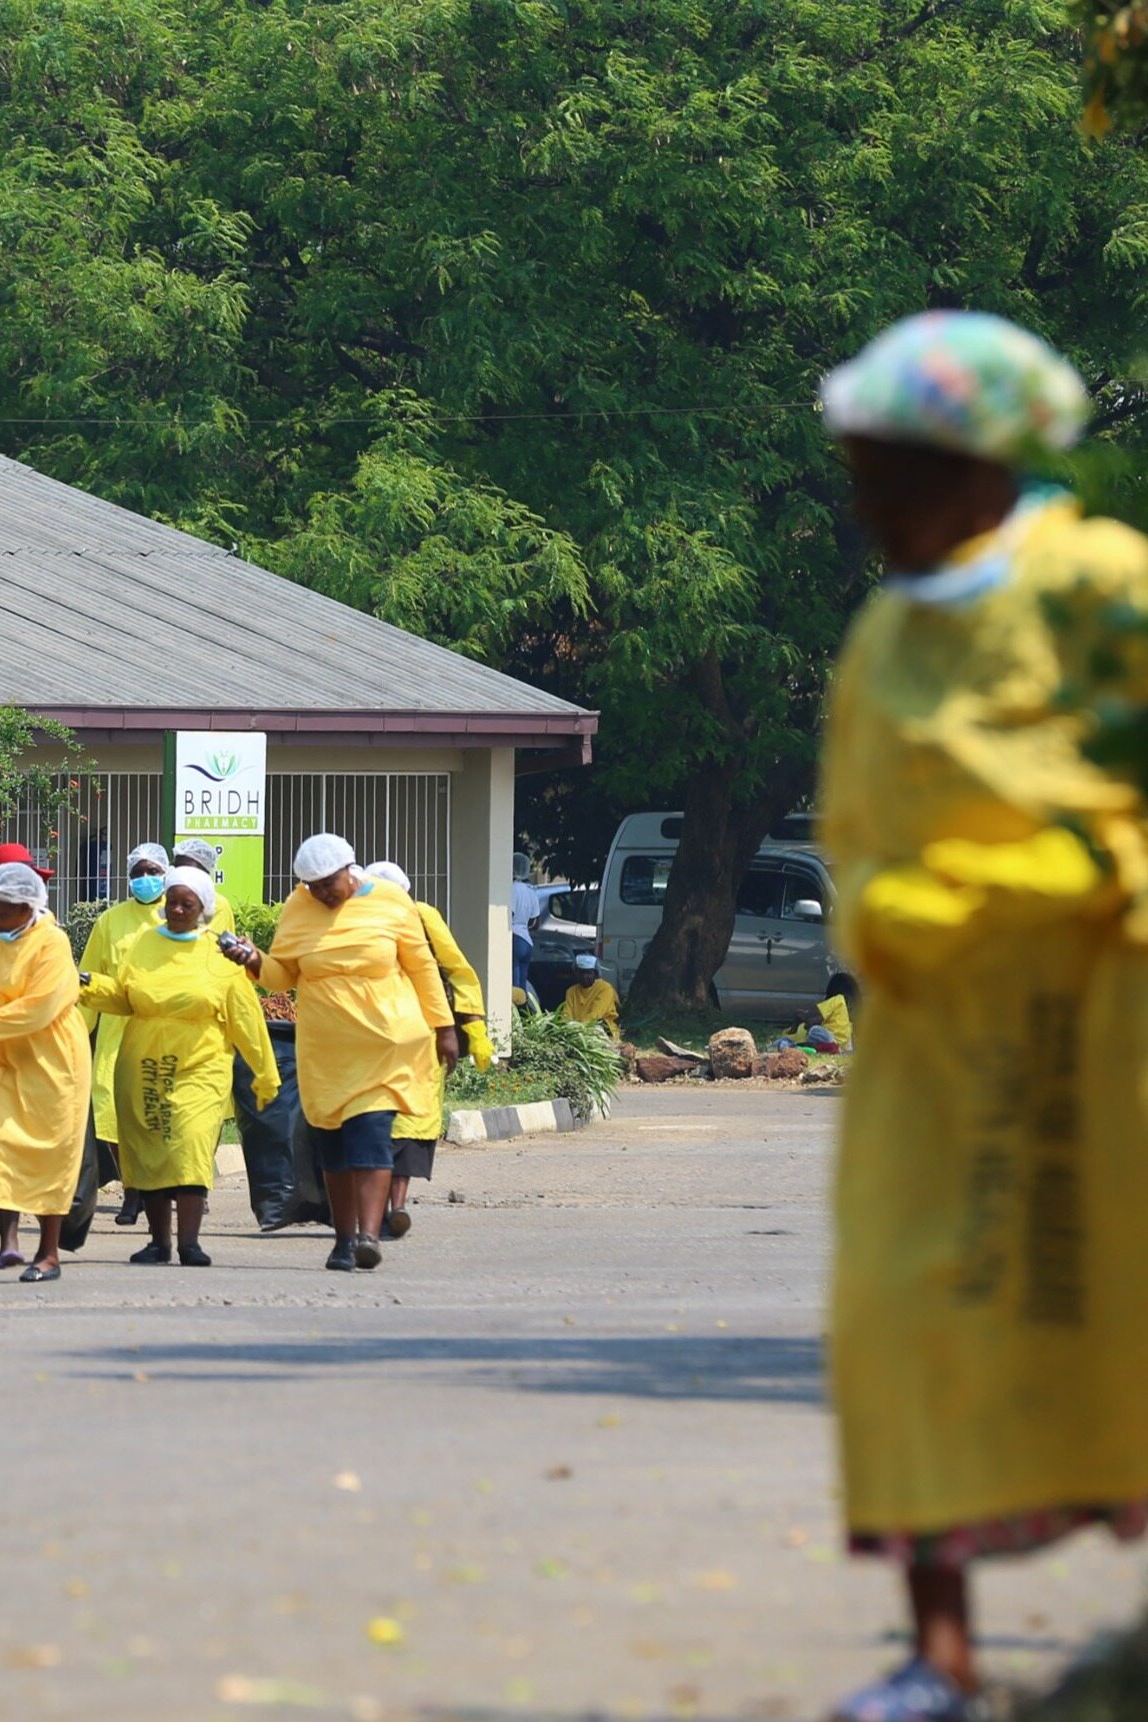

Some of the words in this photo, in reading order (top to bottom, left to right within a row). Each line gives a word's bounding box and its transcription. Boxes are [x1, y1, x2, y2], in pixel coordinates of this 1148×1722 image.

[185, 790, 259, 814] BRIDH
[187, 818, 257, 828] PHARMACY
[141, 1058, 158, 1085] CITY
[142, 1087, 161, 1131] HEALTH
